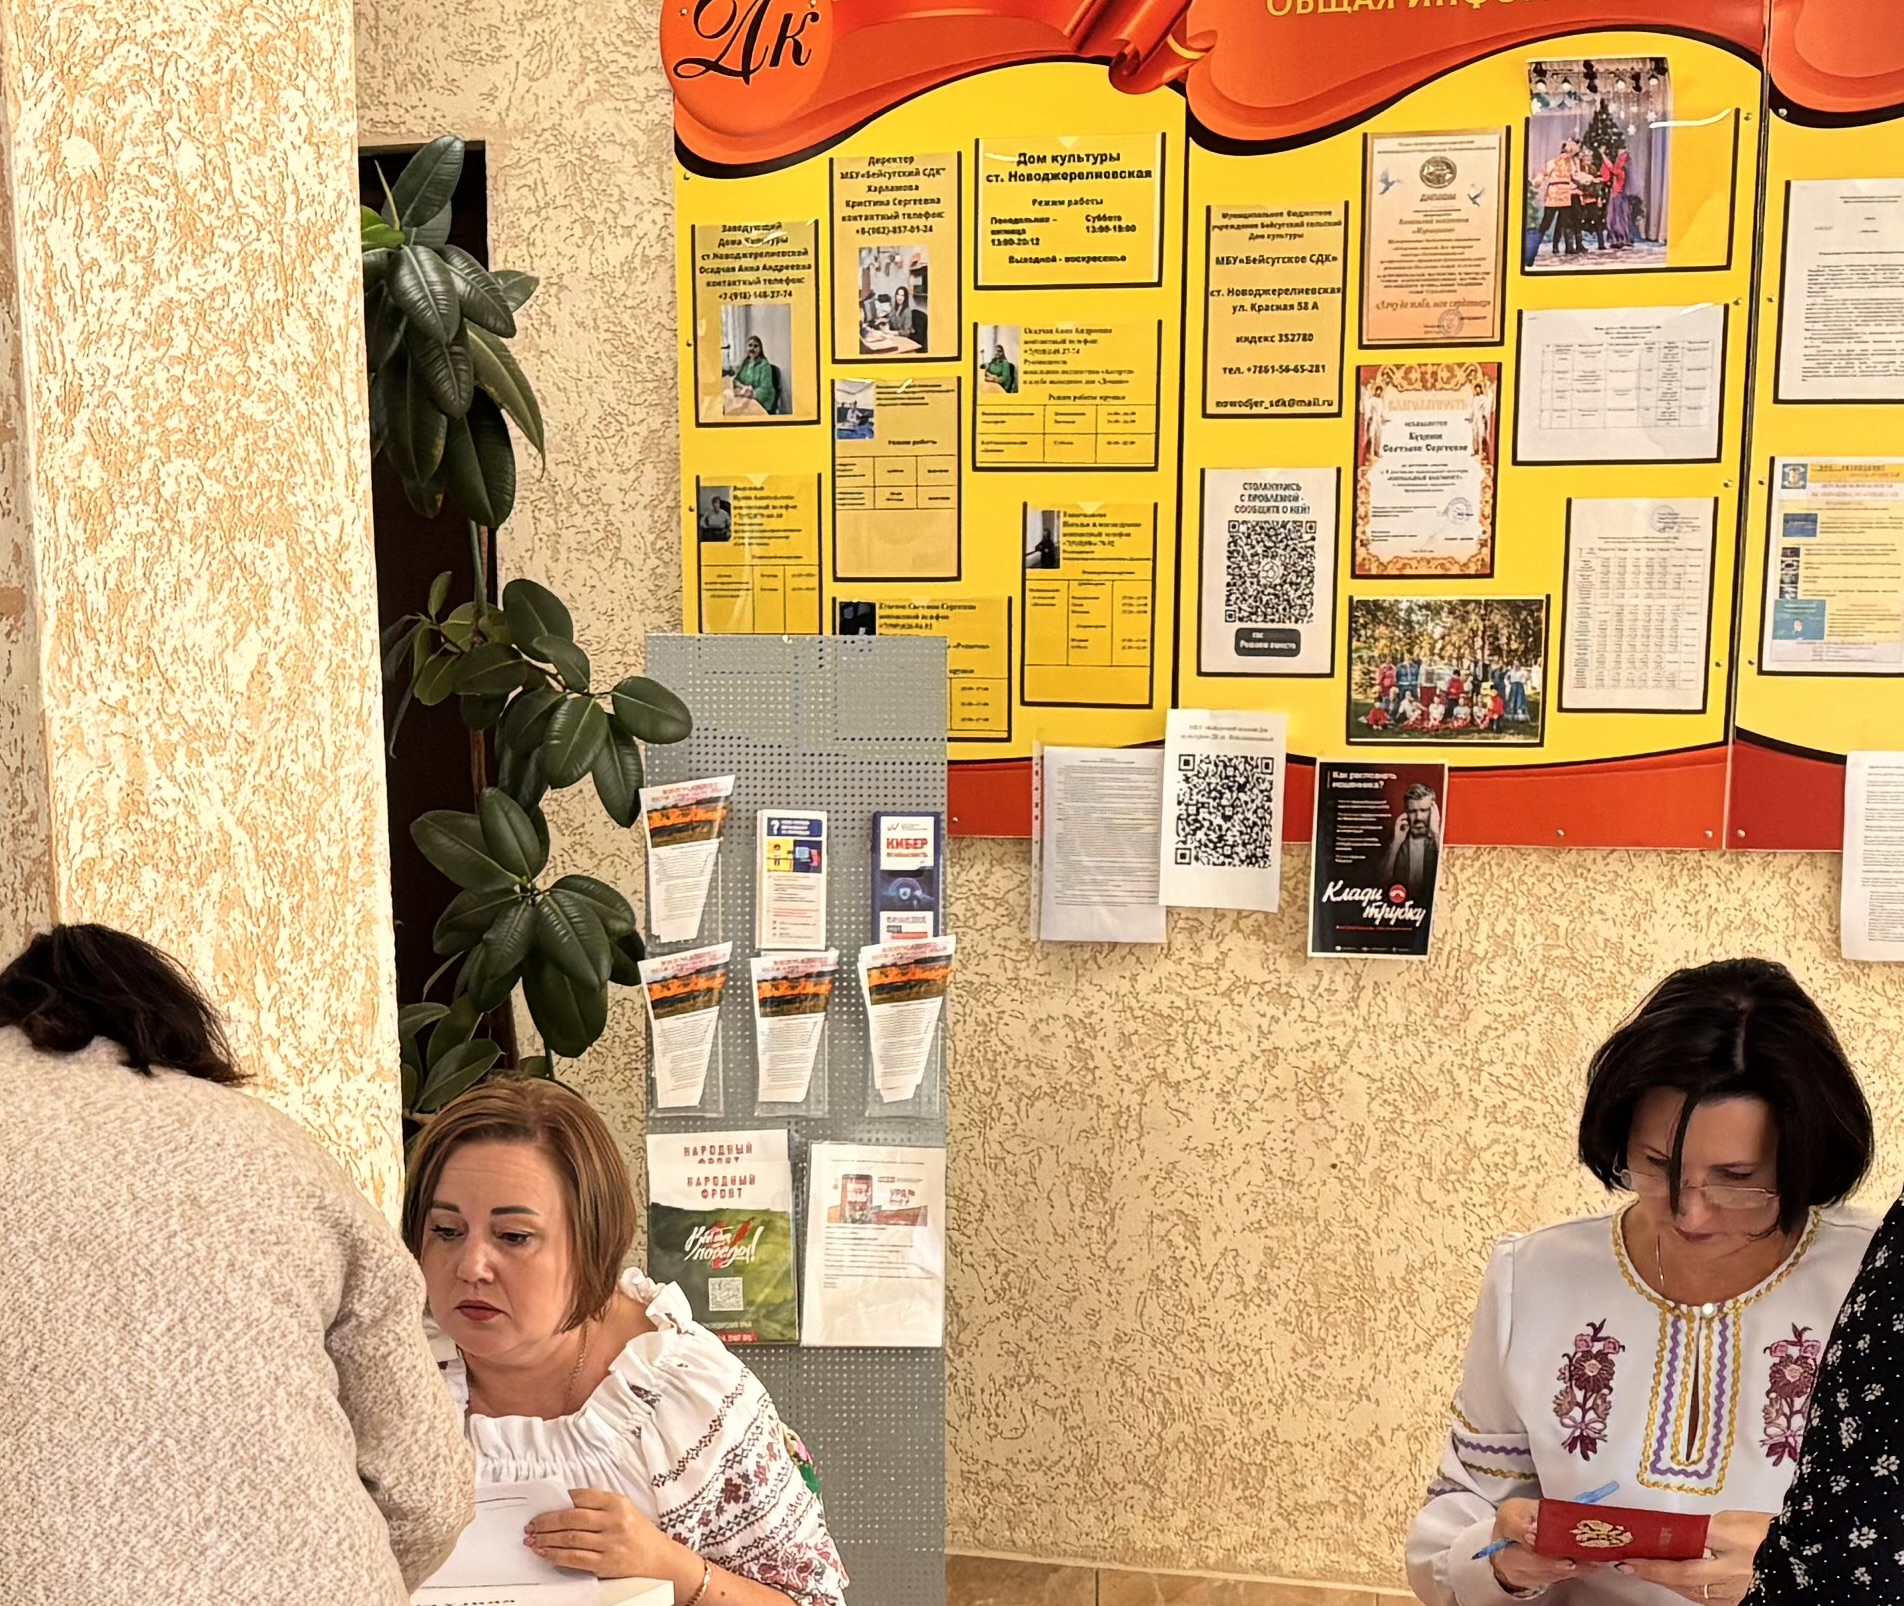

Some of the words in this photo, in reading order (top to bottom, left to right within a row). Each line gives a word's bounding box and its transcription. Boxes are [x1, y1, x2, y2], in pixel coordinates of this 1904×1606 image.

[868, 156, 914, 166] Директор
[1016, 152, 1046, 167] Дом
[1051, 151, 1120, 166] культуры
[986, 173, 1004, 183] ст.
[1232, 304, 1247, 314] ул.
[1250, 302, 1295, 313] Красная
[1236, 335, 1276, 345] индекс
[1223, 366, 1244, 375] тел.
[886, 838, 928, 849] КИБЕР
[1322, 880, 1382, 907] Клади
[1363, 900, 1426, 927] трубку
[684, 1142, 752, 1157] НАРОДНЫЙ
[687, 1174, 755, 1187] НАРОДНЫЙ
[701, 1188, 743, 1199] ФРОНТ
